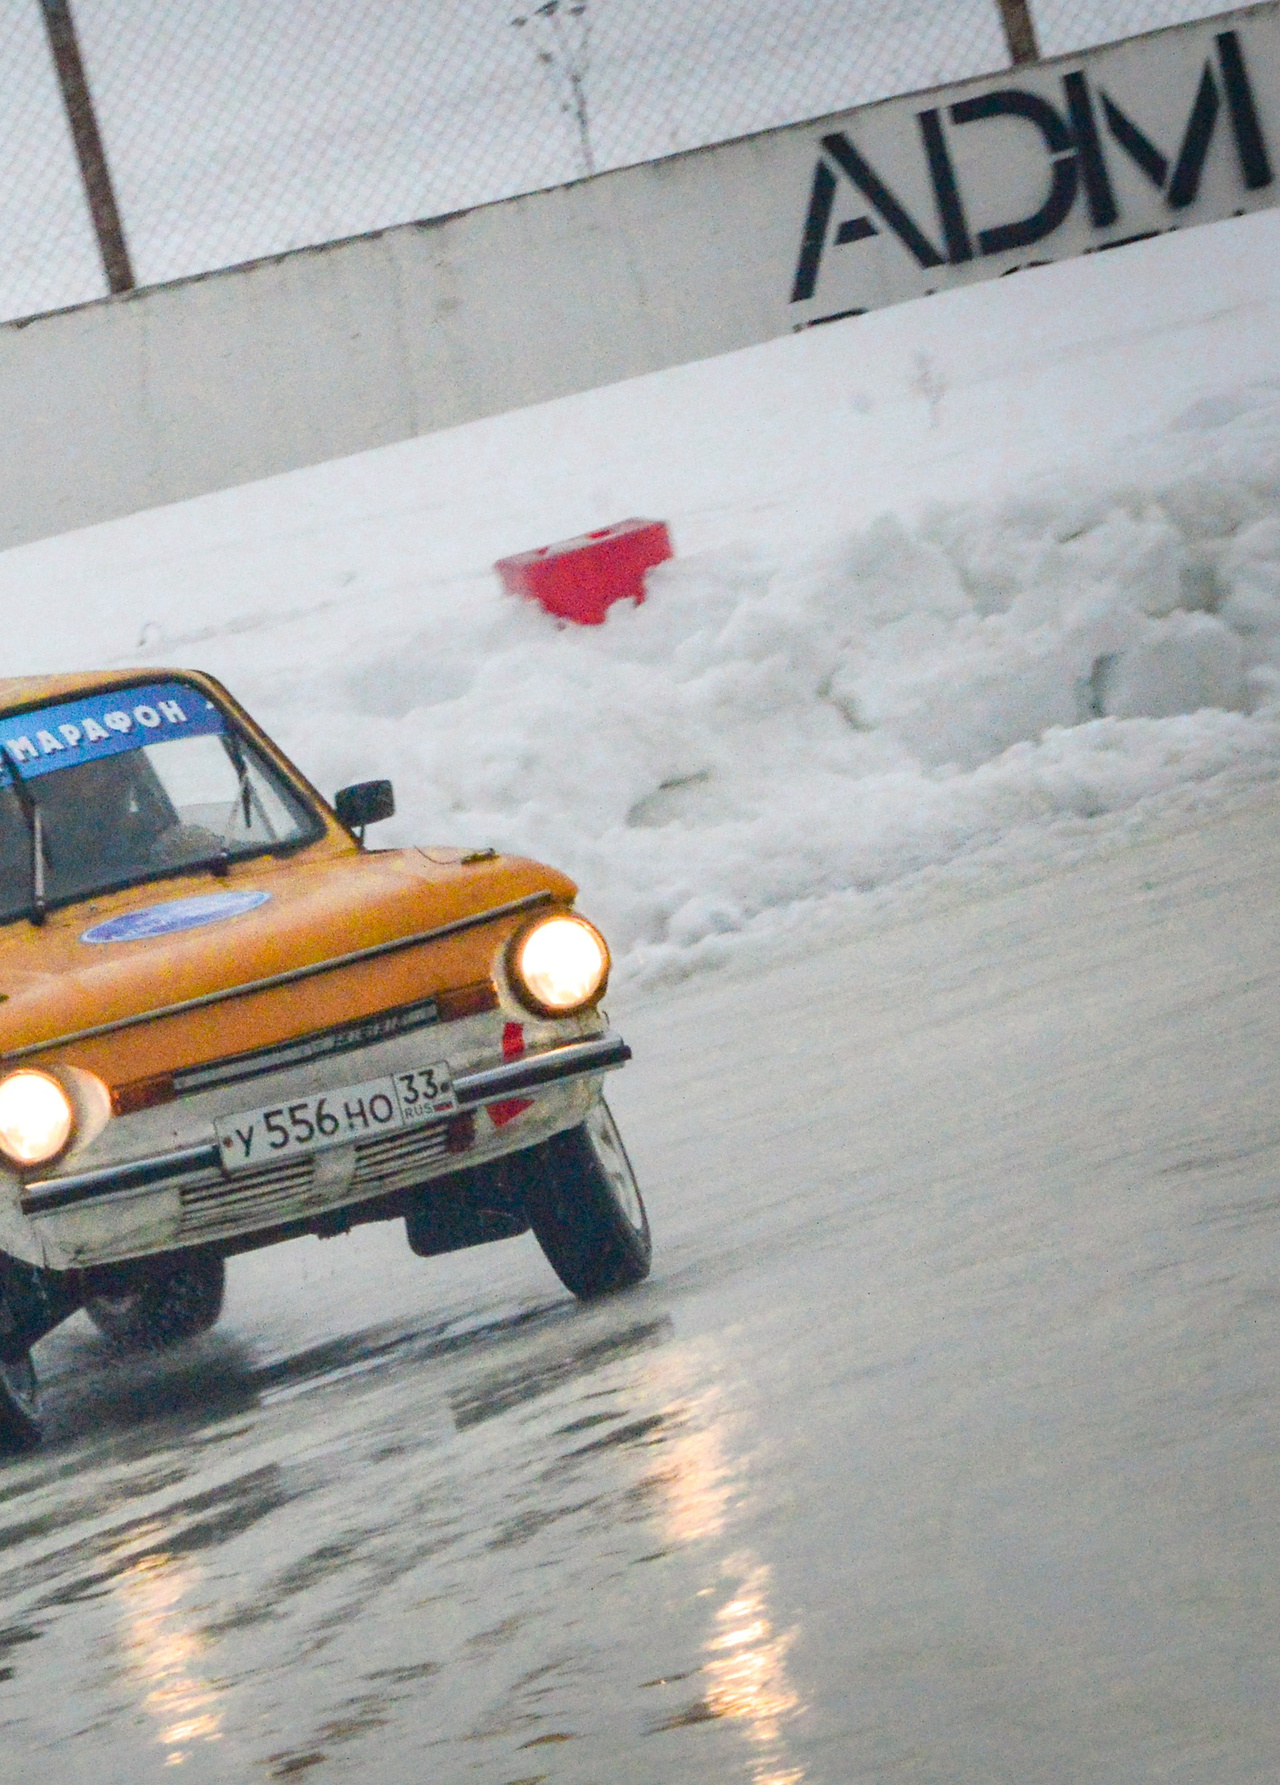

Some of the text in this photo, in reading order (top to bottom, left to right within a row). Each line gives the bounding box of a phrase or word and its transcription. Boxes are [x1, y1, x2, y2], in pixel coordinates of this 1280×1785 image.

[790, 30, 1276, 304] ADM
[6, 699, 188, 762] МАРАФОН
[404, 1104, 434, 1119] RUS
